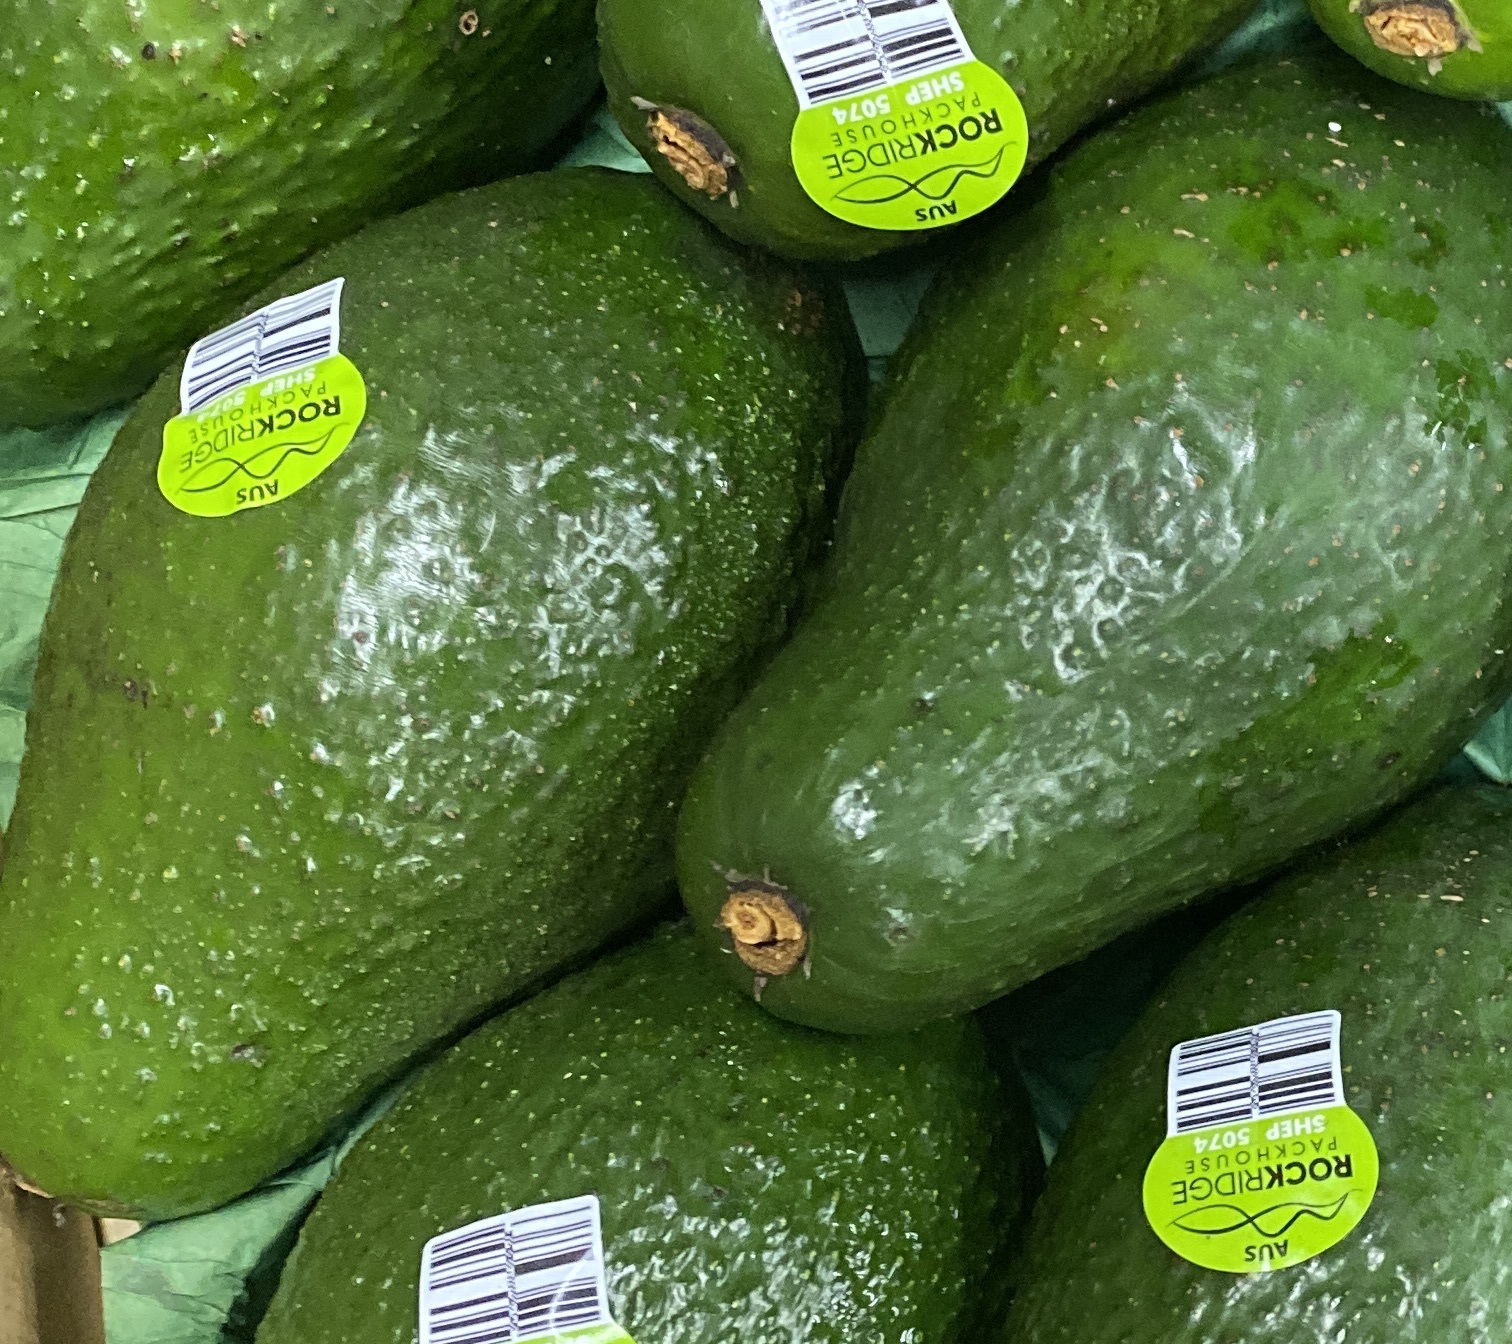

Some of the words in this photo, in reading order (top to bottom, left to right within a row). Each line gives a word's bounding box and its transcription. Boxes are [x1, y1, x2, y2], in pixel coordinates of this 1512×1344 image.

[905, 71, 965, 106] SHEP
[830, 92, 981, 146] PACKHOUSE
[831, 94, 891, 125] 5074
[822, 108, 1003, 179] ROCKRIDGE
[915, 200, 957, 222] AUS
[260, 366, 316, 396] SHEP
[188, 381, 326, 443] PACKHOUSE
[179, 395, 341, 473] ROCKRIDGE
[236, 479, 279, 504] AUS
[1193, 1128, 1250, 1153] 5074
[1265, 1114, 1326, 1140] SHEP
[1184, 1136, 1337, 1175] PACKHOUSE
[1171, 1154, 1353, 1205] ROCKRIDGE
[1244, 1239, 1288, 1262] AUS
